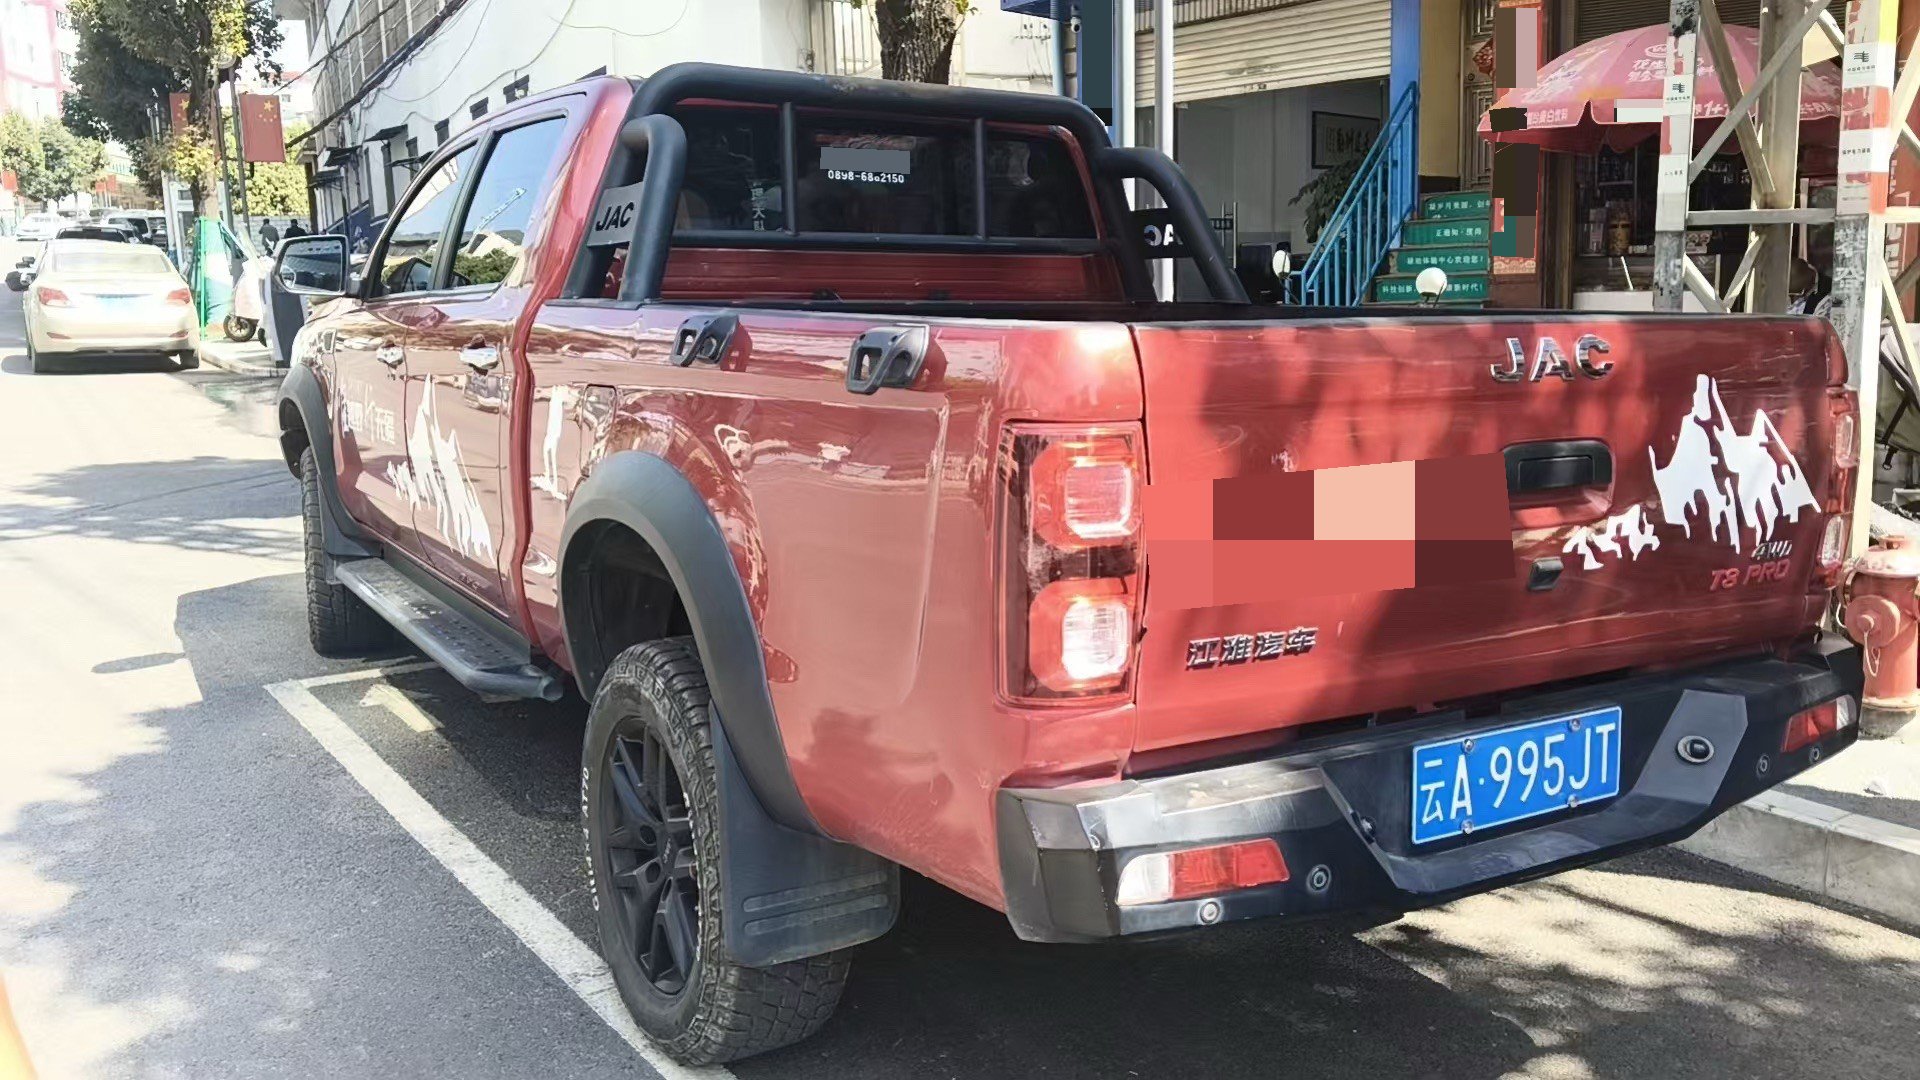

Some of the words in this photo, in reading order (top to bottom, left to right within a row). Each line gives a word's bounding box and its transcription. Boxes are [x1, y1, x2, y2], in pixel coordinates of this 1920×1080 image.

[595, 201, 635, 231] JAC
[1490, 334, 1615, 383] JAC
[1710, 567, 1740, 591] T8
[1742, 558, 1791, 585] PRO
[1186, 626, 1319, 670] 江淮汽车
[1419, 722, 1616, 825] 云A·995JT
